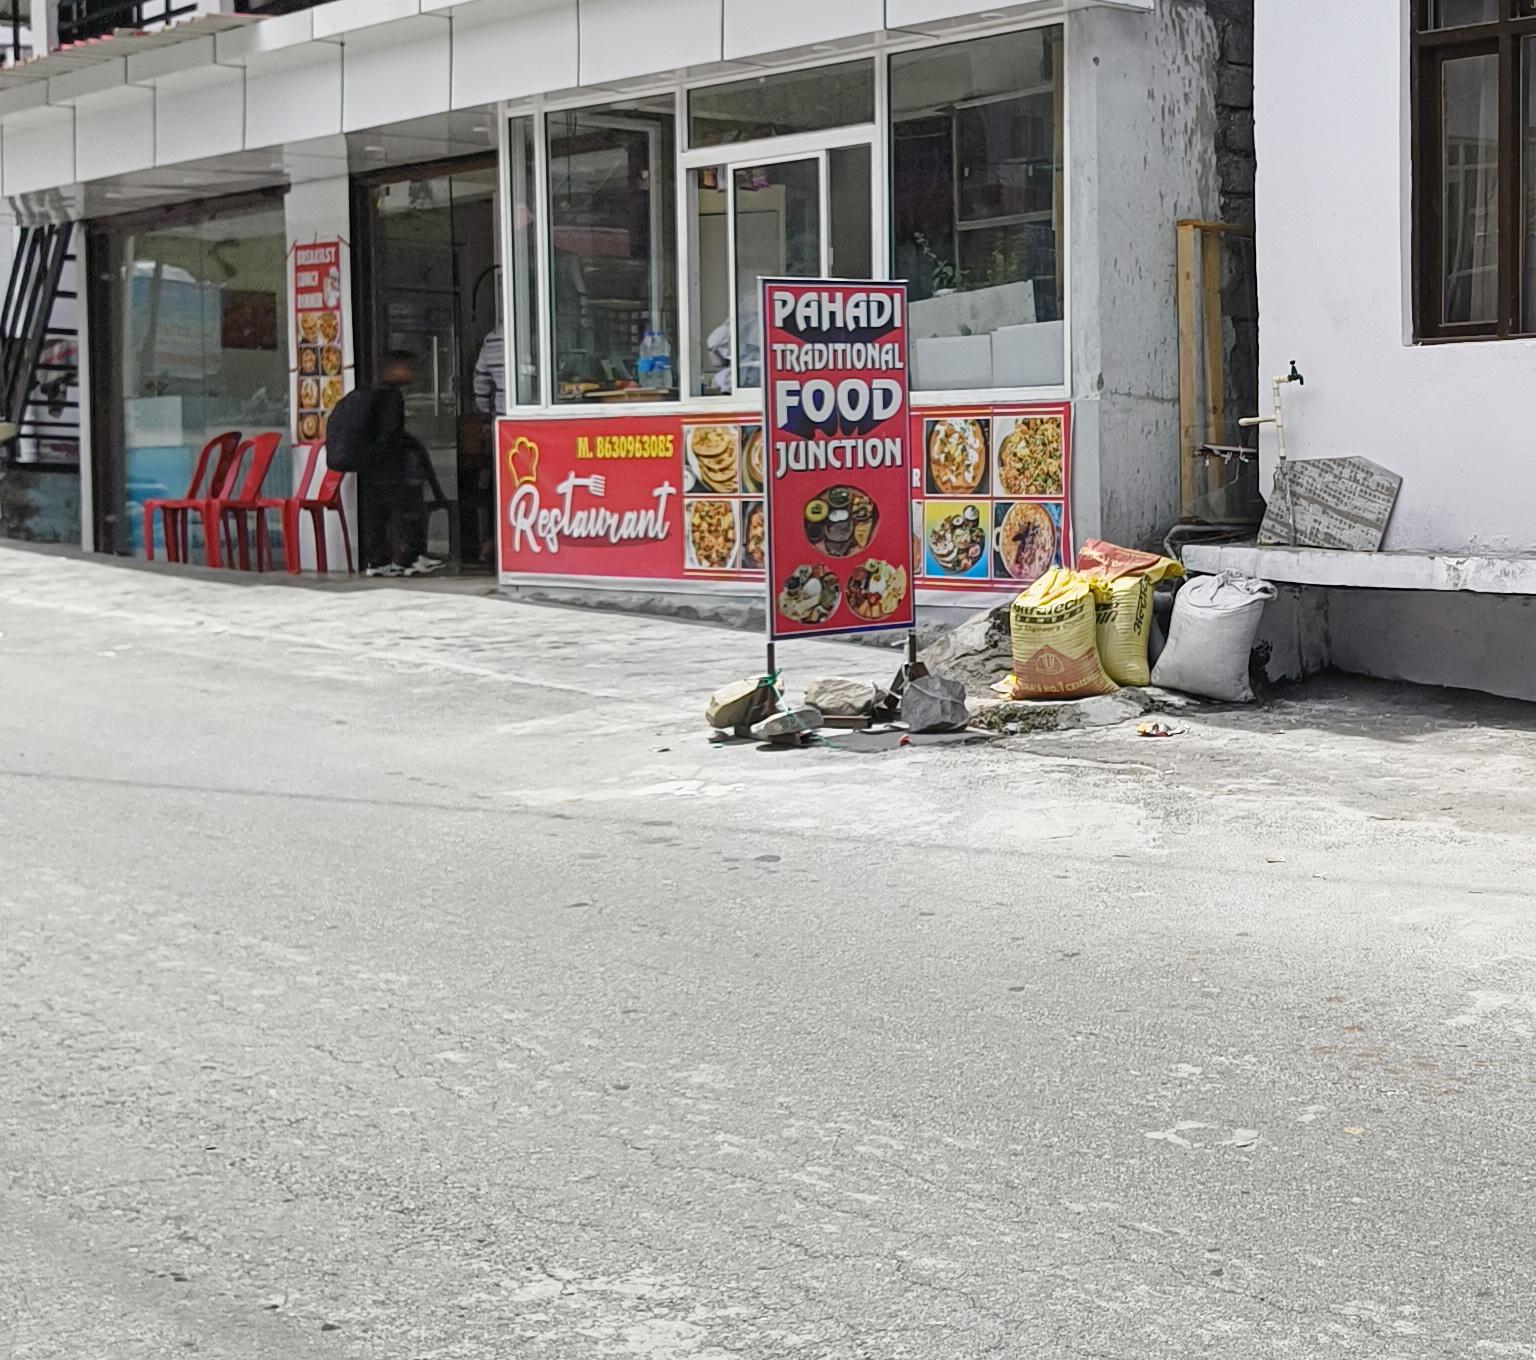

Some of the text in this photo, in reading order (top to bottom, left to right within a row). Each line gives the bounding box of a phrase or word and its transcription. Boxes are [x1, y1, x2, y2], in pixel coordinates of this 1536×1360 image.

[773, 291, 902, 332] PAHADI
[772, 342, 904, 374] TRADITIONAL
[776, 378, 903, 429] FOOD
[576, 434, 675, 459] M. 8630963085
[776, 437, 902, 479] JUNCTION
[509, 470, 678, 554] Restaurant
